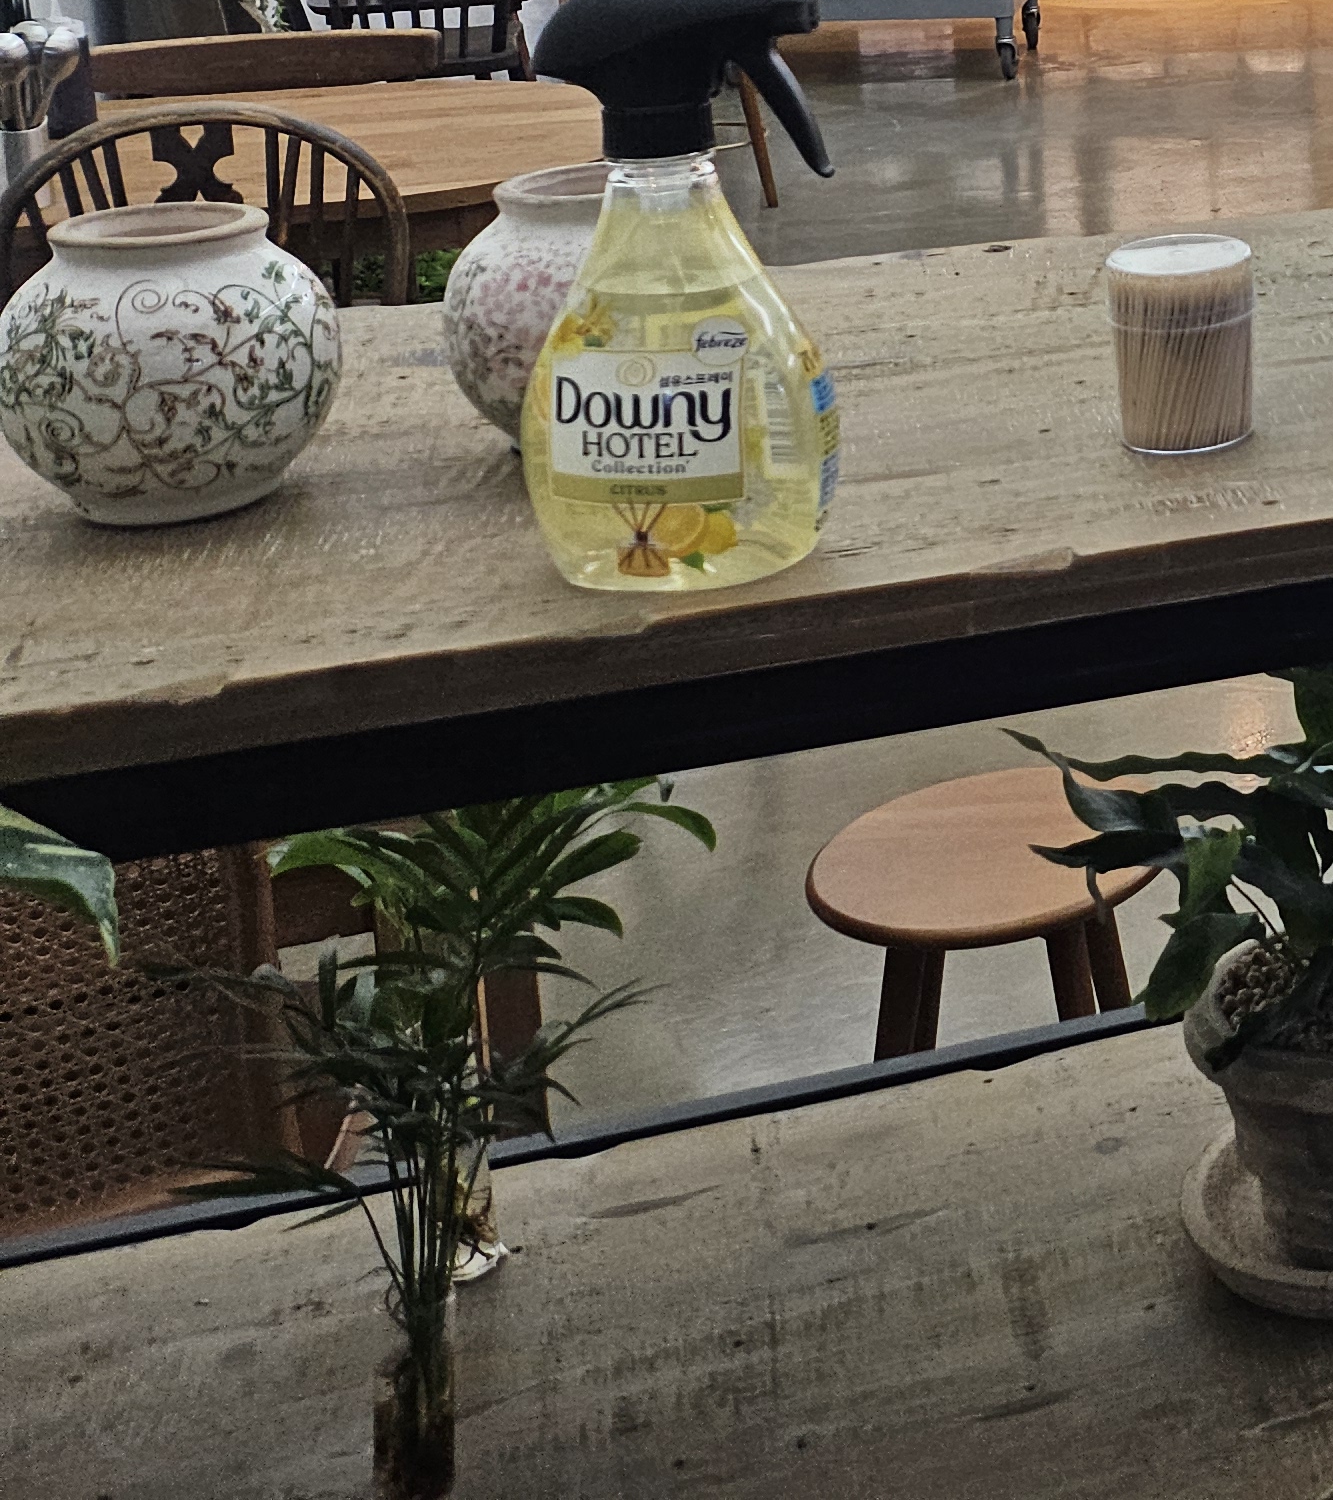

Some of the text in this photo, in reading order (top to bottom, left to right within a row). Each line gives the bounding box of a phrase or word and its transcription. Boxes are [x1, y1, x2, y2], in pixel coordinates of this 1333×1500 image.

[555, 375, 732, 443] Downy
[582, 430, 699, 459] HOTEL
[609, 483, 667, 496] CITRUS
